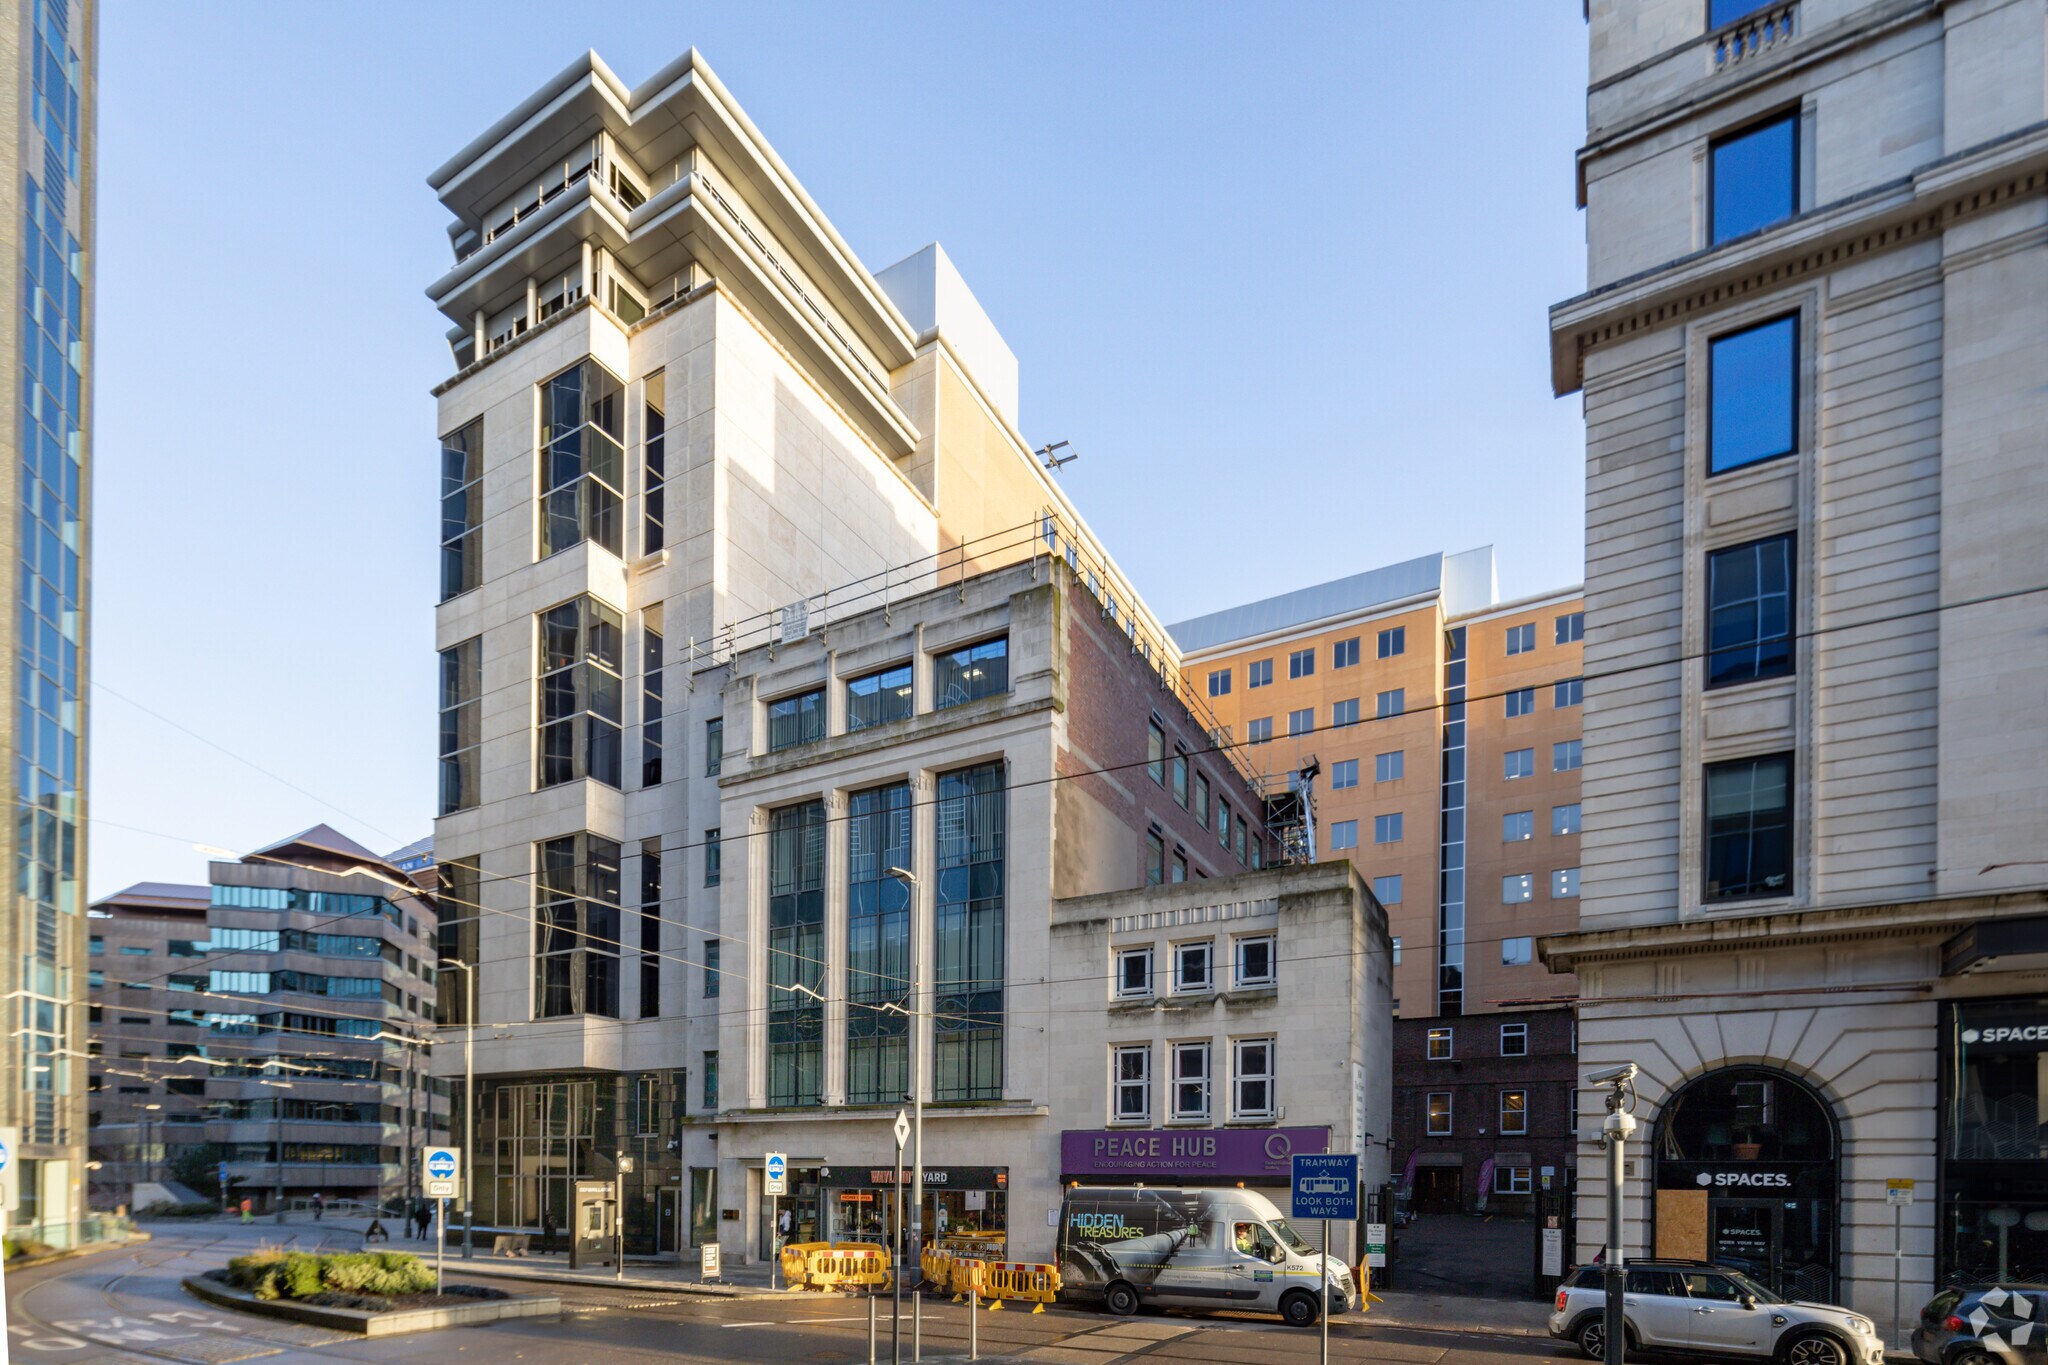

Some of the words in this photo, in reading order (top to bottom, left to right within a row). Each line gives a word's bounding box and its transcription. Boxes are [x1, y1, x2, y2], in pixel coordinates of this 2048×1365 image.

[1094, 1137, 1161, 1156] PEACE
[1172, 1137, 1217, 1156] HUB
[1300, 1159, 1349, 1167] TRAMWAY
[922, 1172, 948, 1183] YARD
[1714, 1173, 1792, 1187] SPACES.
[1296, 1197, 1322, 1206] LOOK
[1326, 1197, 1353, 1206] BOTH
[1310, 1207, 1338, 1216] WAYS
[1070, 1213, 1124, 1228] HIDDEN
[1078, 1226, 1144, 1239] TREASURES
